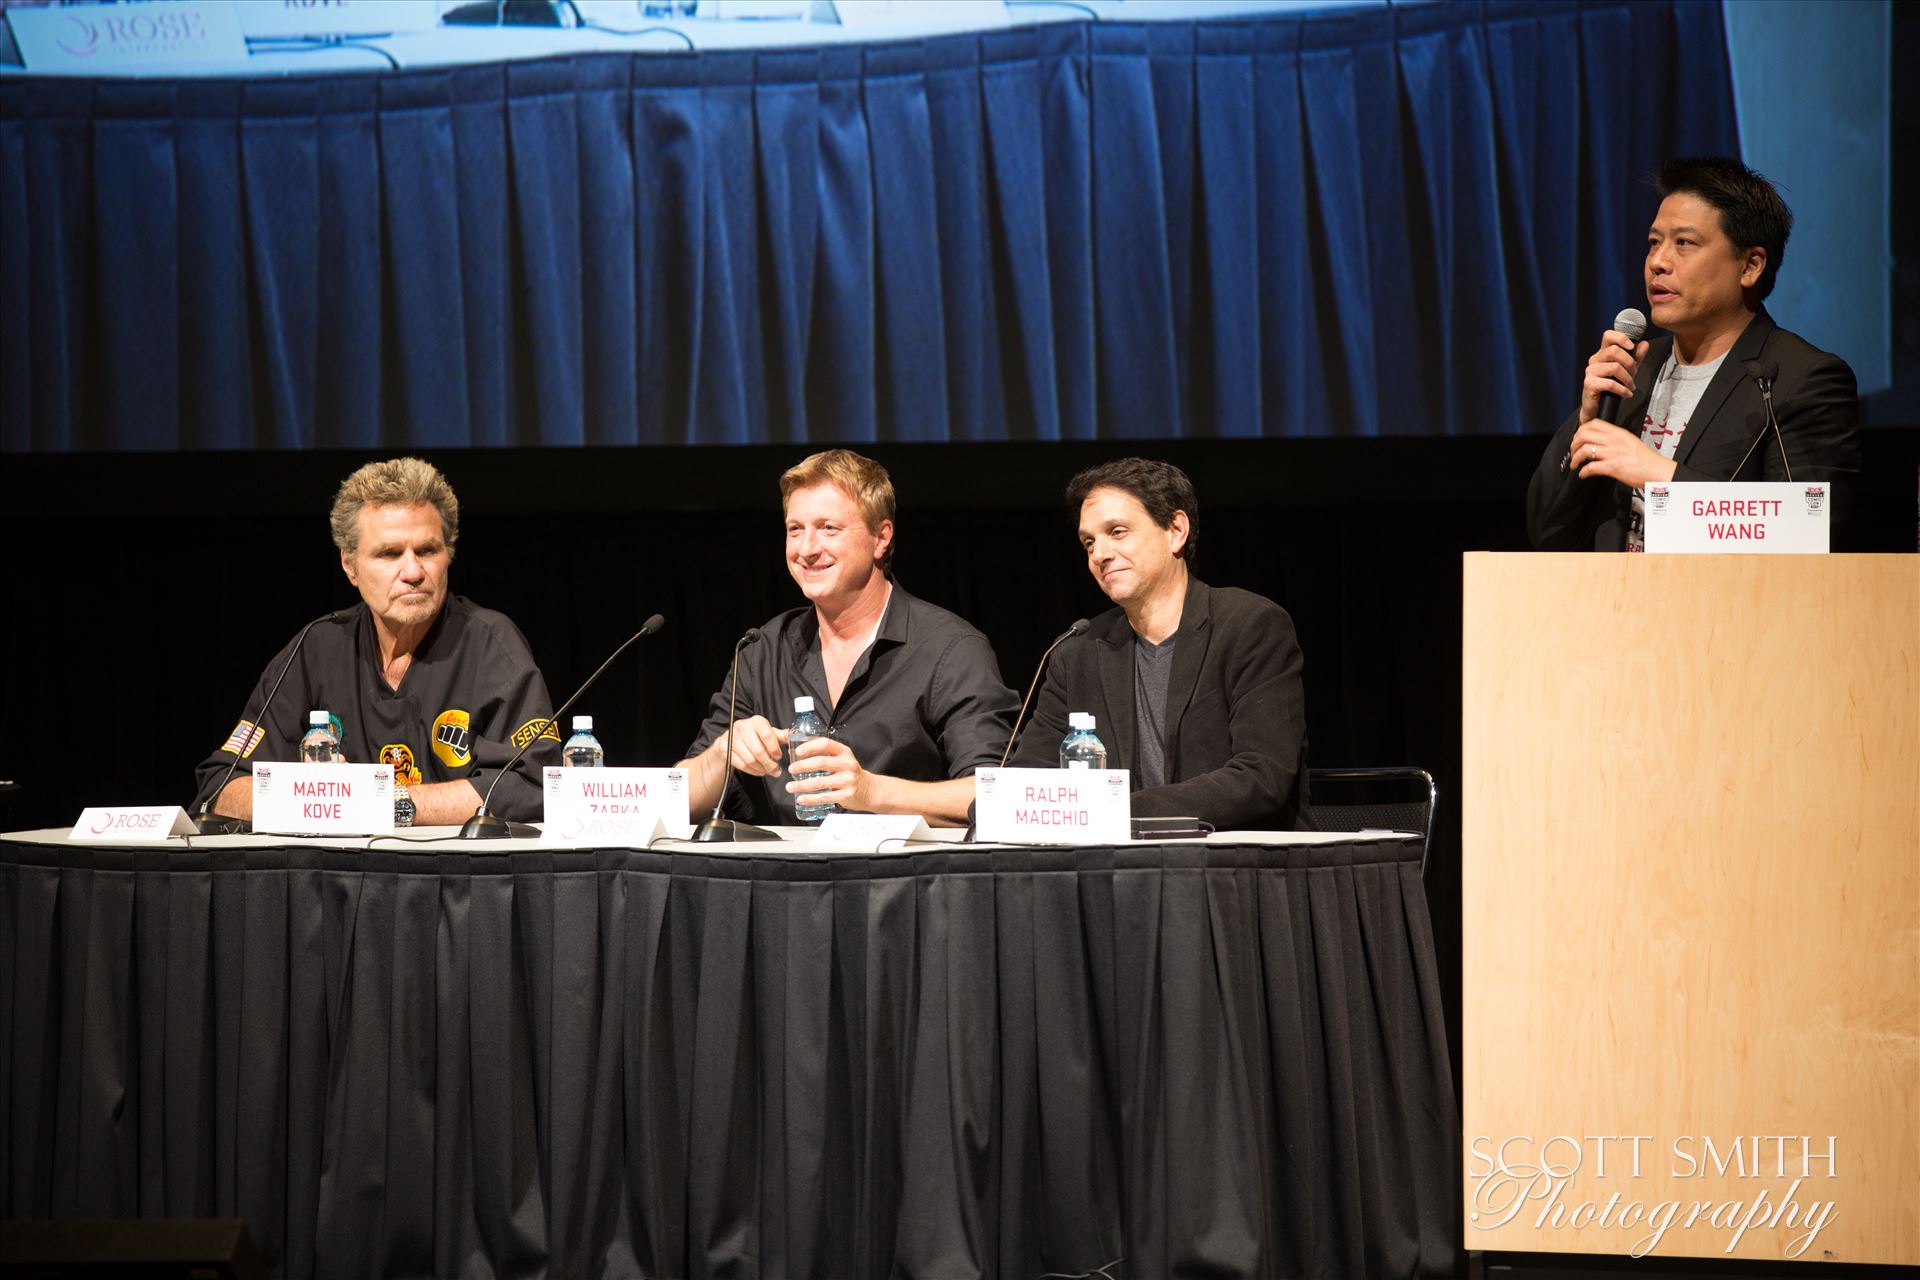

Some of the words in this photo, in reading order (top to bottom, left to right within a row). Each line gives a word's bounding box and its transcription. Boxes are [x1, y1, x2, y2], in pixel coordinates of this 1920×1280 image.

[104, 12, 205, 42] ROSE
[1692, 500, 1782, 517] GARRETT
[1708, 523, 1766, 539] WANG
[294, 782, 351, 798] MARTIN
[582, 782, 647, 798] WILLIAM
[1026, 787, 1078, 802] RALPH
[303, 804, 341, 819] KOVE
[1016, 809, 1088, 825] MACCHIO
[114, 813, 161, 828] ROSE
[587, 820, 639, 834] ROSE
